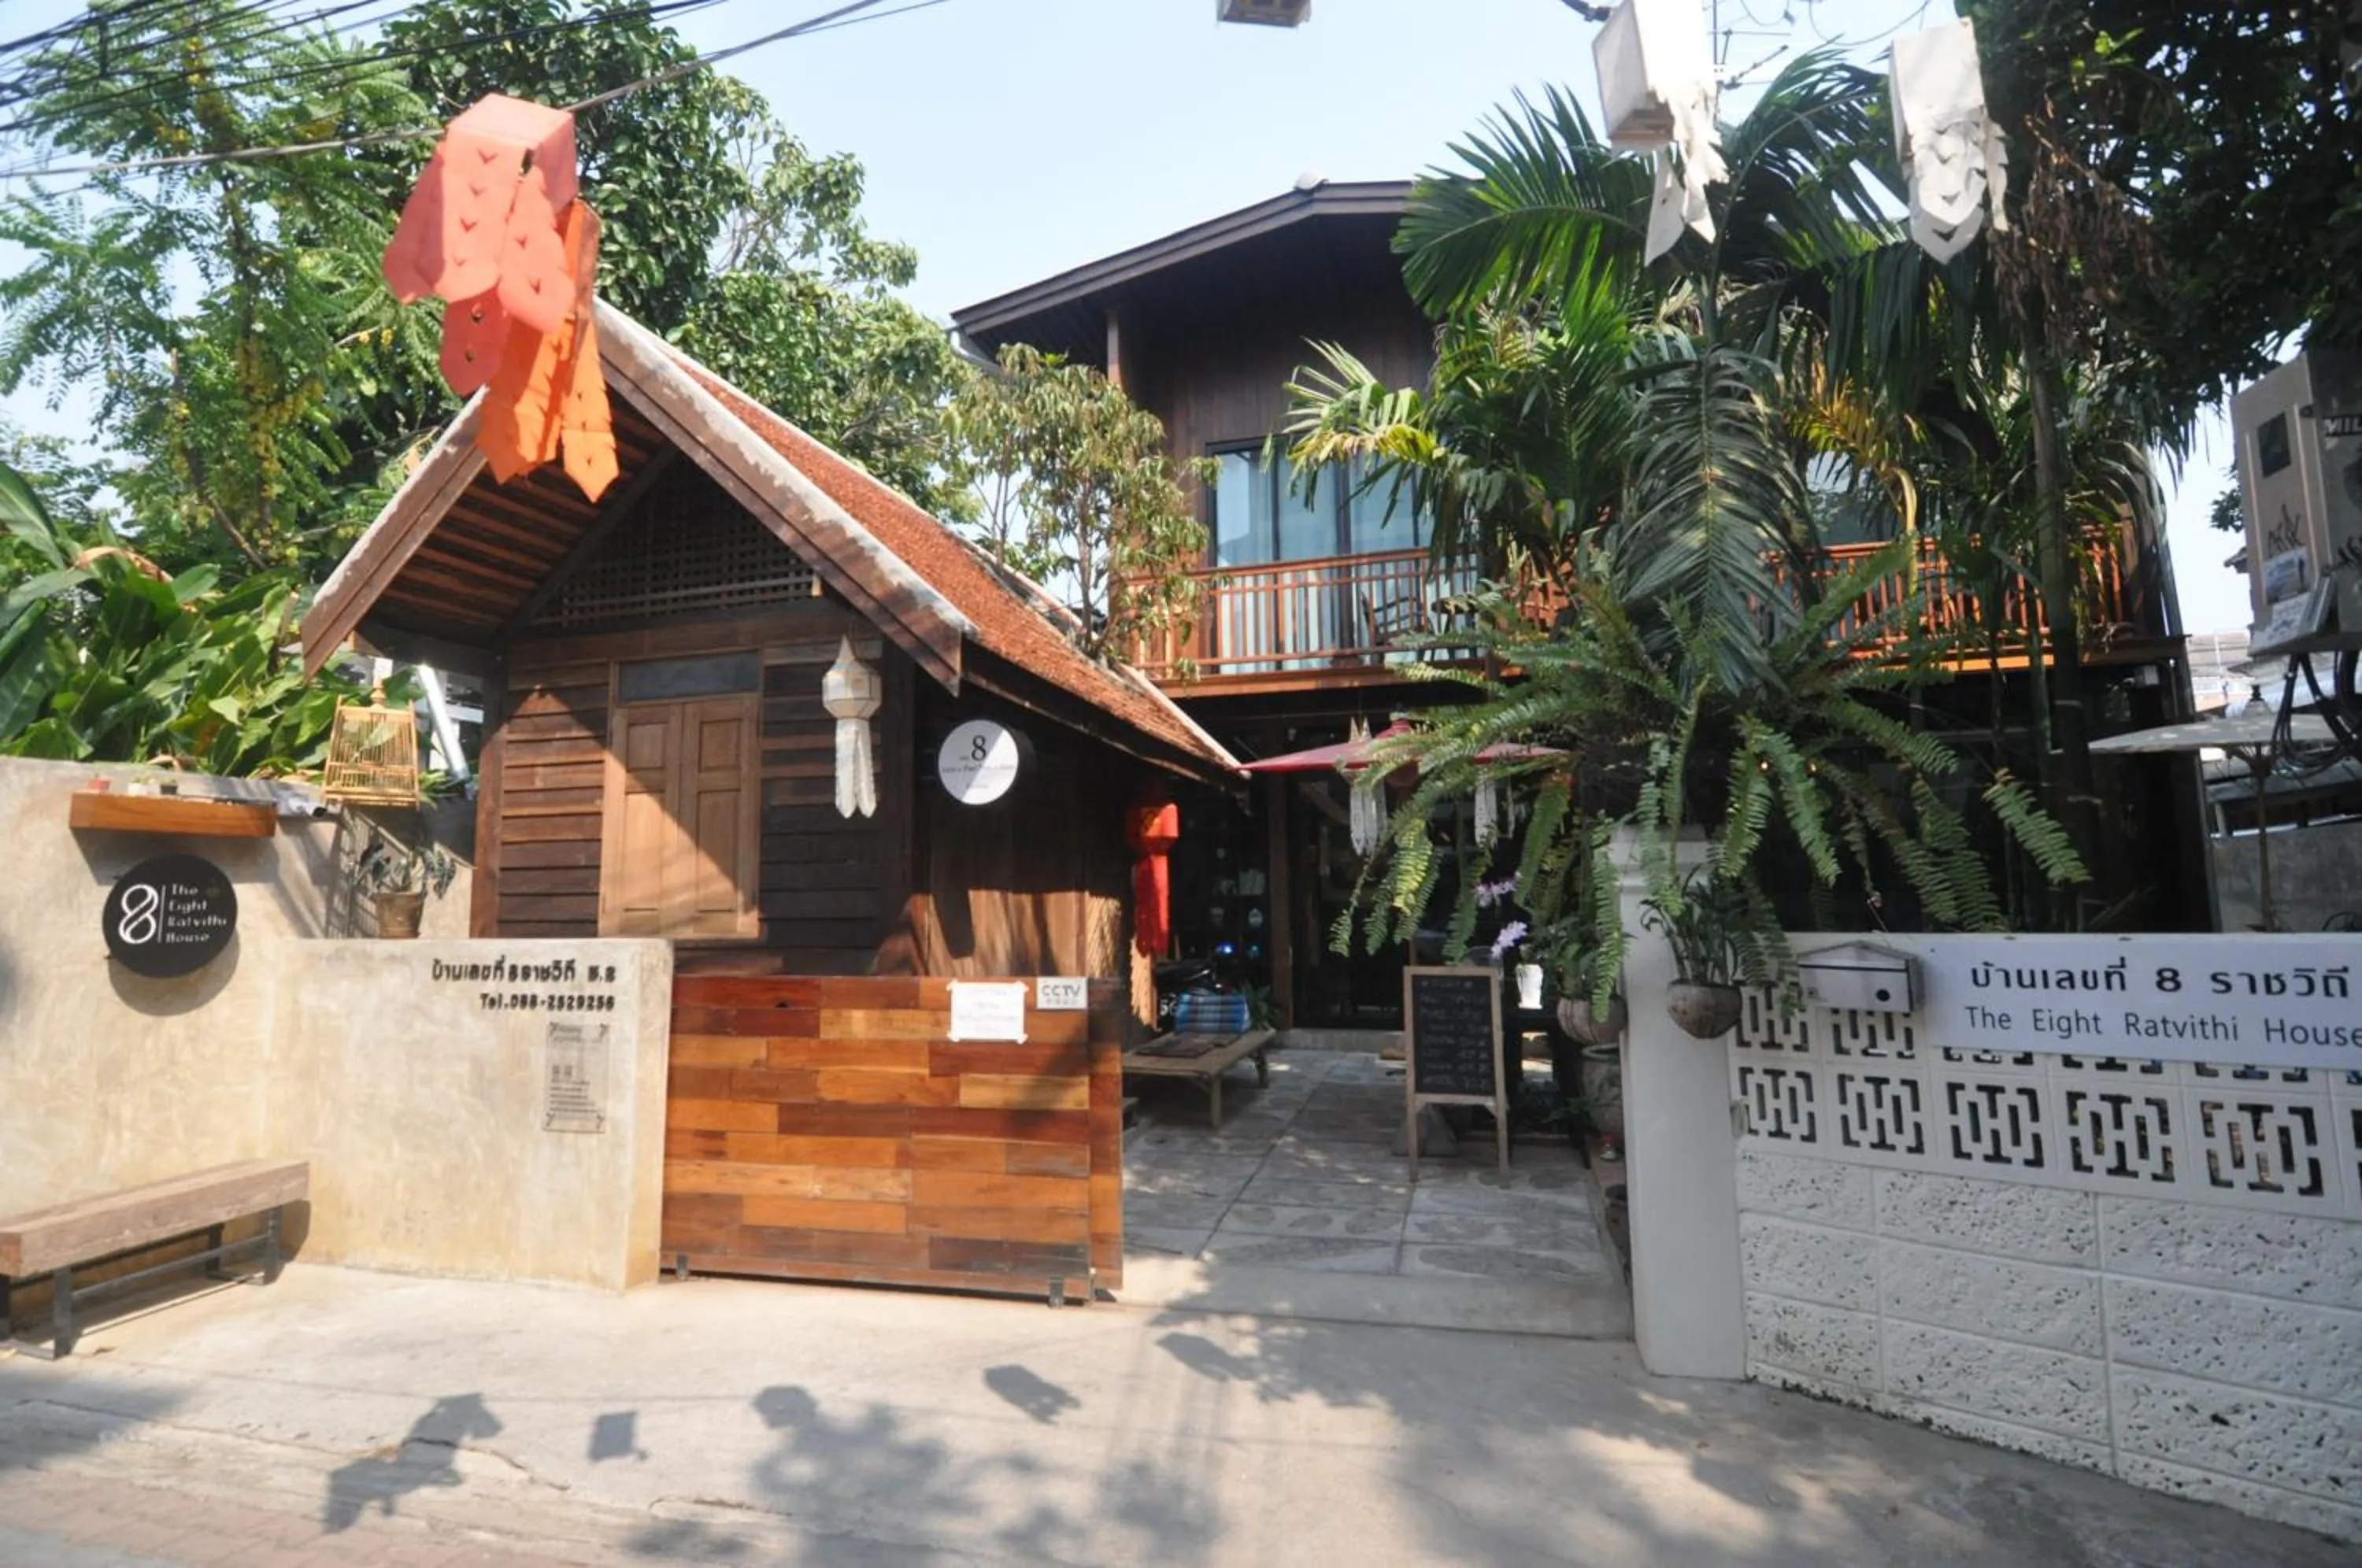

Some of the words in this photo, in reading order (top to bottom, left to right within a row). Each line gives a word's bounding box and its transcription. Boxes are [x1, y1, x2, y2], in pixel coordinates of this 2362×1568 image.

[971, 734, 987, 761] 8
[172, 883, 198, 896] The
[168, 900, 207, 914] Eight
[119, 884, 159, 945] 8
[167, 915, 227, 927] Ratvithi
[166, 932, 211, 944] House
[1971, 956, 2127, 992] บ้านเลขที่
[2155, 967, 2182, 993] 8
[2210, 965, 2349, 998] ราชวิถี
[1042, 985, 1081, 997] CCTV
[1964, 1005, 2012, 1030] The
[2032, 1008, 2103, 1040] Eight
[2124, 1011, 2238, 1041] Ratvithi
[2264, 1017, 2362, 1048] House
